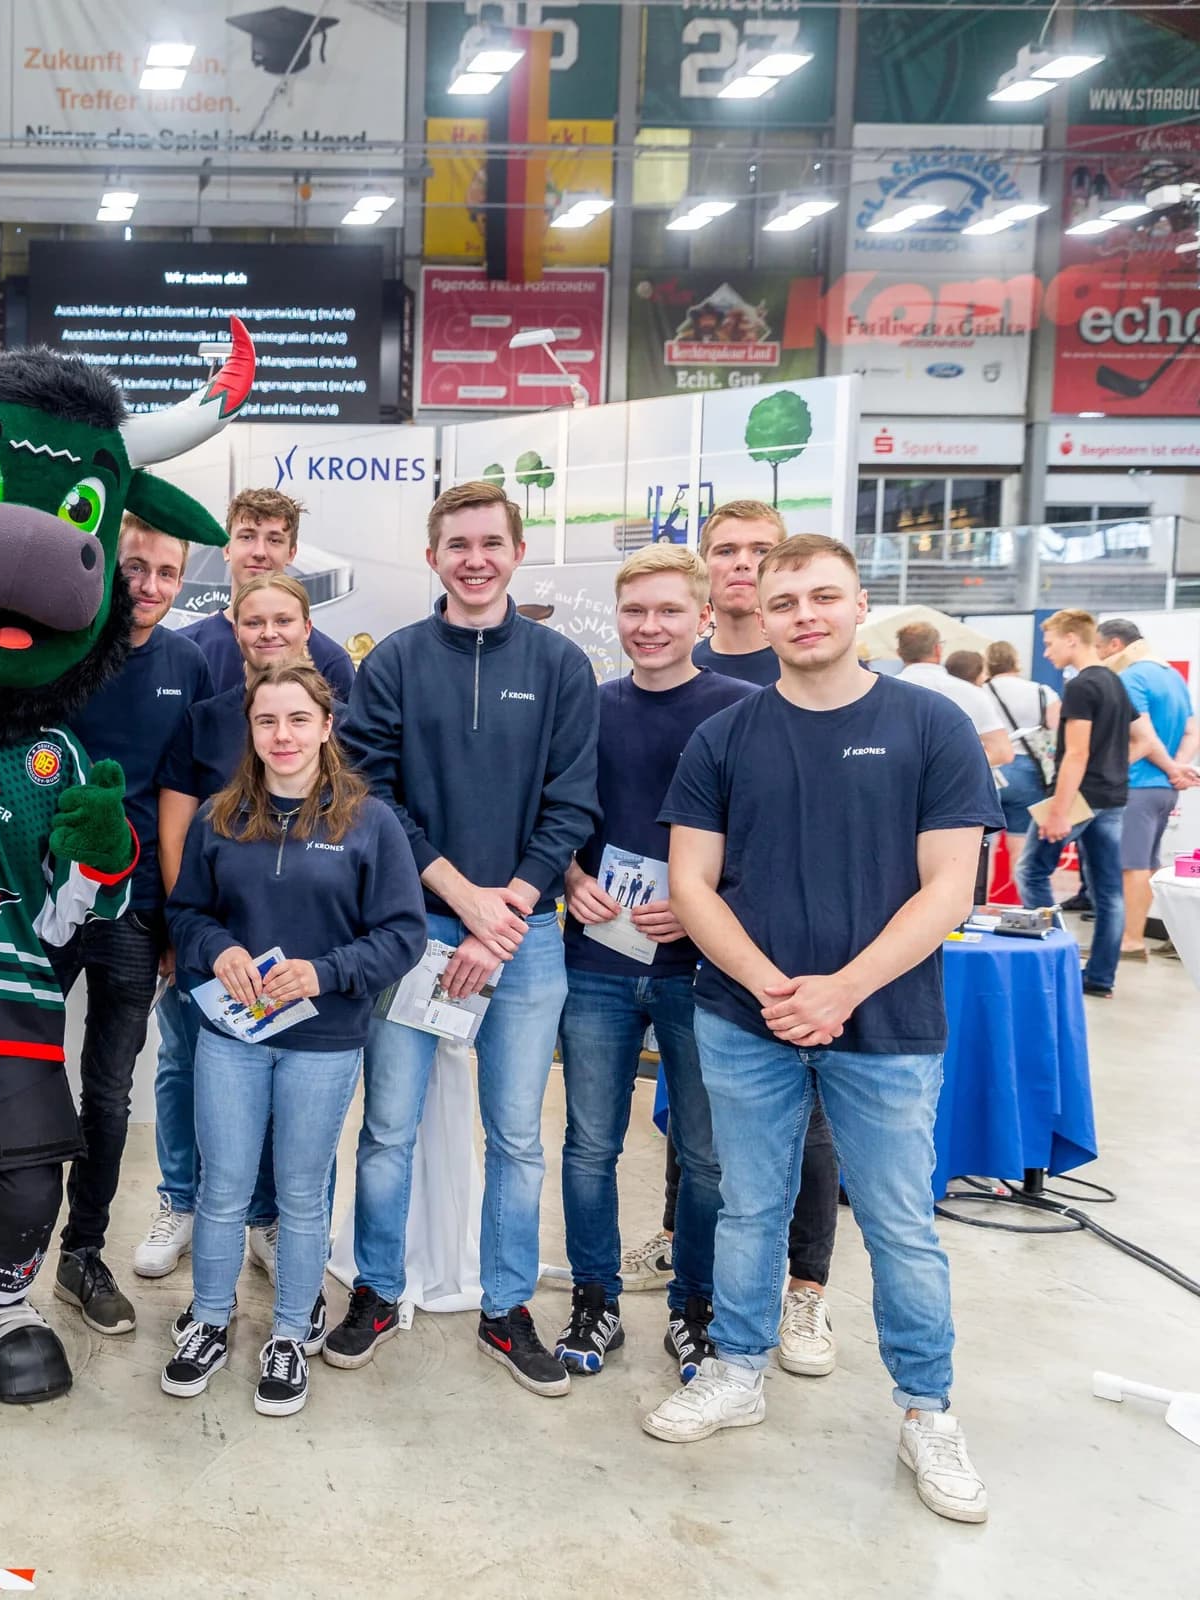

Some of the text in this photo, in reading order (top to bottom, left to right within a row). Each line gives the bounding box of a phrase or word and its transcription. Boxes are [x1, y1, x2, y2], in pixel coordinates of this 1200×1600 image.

[24, 48, 123, 72] Zukunft
[56, 88, 138, 112] Treffer
[164, 271, 248, 285] Wir suchen dich
[676, 370, 723, 389] Echt.
[902, 441, 979, 457] Sparkasse
[1081, 444, 1149, 458] Begeistern
[1151, 445, 1167, 457] ist
[308, 456, 426, 482] KRONES
[852, 747, 887, 756] KRONES
[314, 843, 345, 852] KRONES
